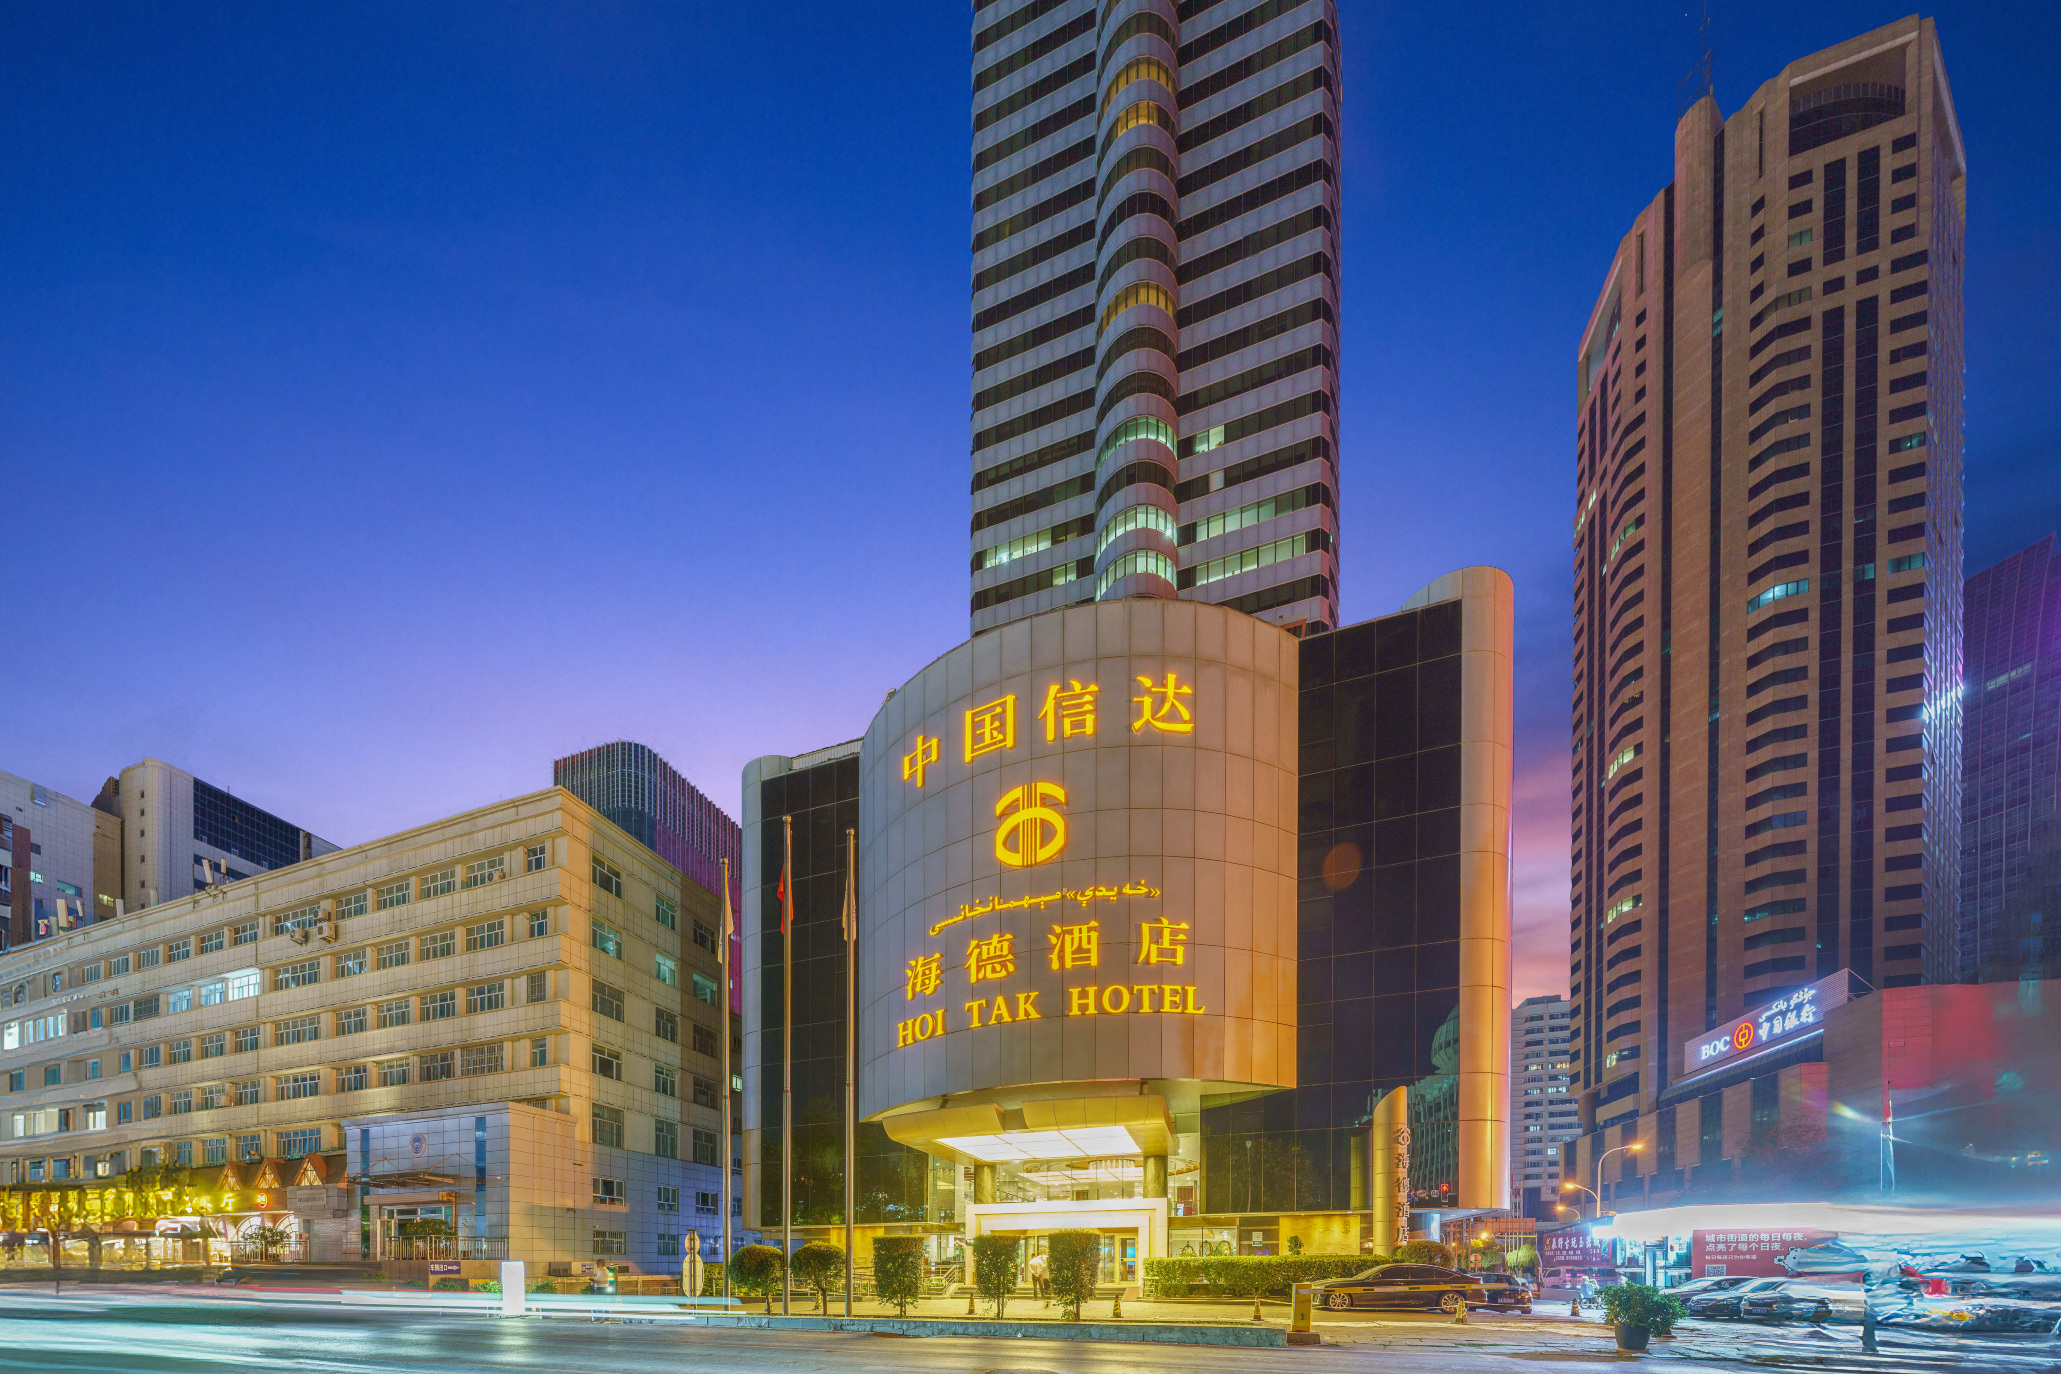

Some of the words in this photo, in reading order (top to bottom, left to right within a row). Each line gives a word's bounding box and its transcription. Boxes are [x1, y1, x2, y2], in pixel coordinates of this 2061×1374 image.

[903, 673, 1195, 788] 中国信达
[905, 916, 1191, 1000] 海德酒店
[897, 1009, 947, 1049] HOI
[965, 992, 1042, 1029] TAK
[1068, 984, 1206, 1015] HOTEL
[1701, 1036, 1730, 1060] BOC
[1758, 1004, 1816, 1041] 中国银行
